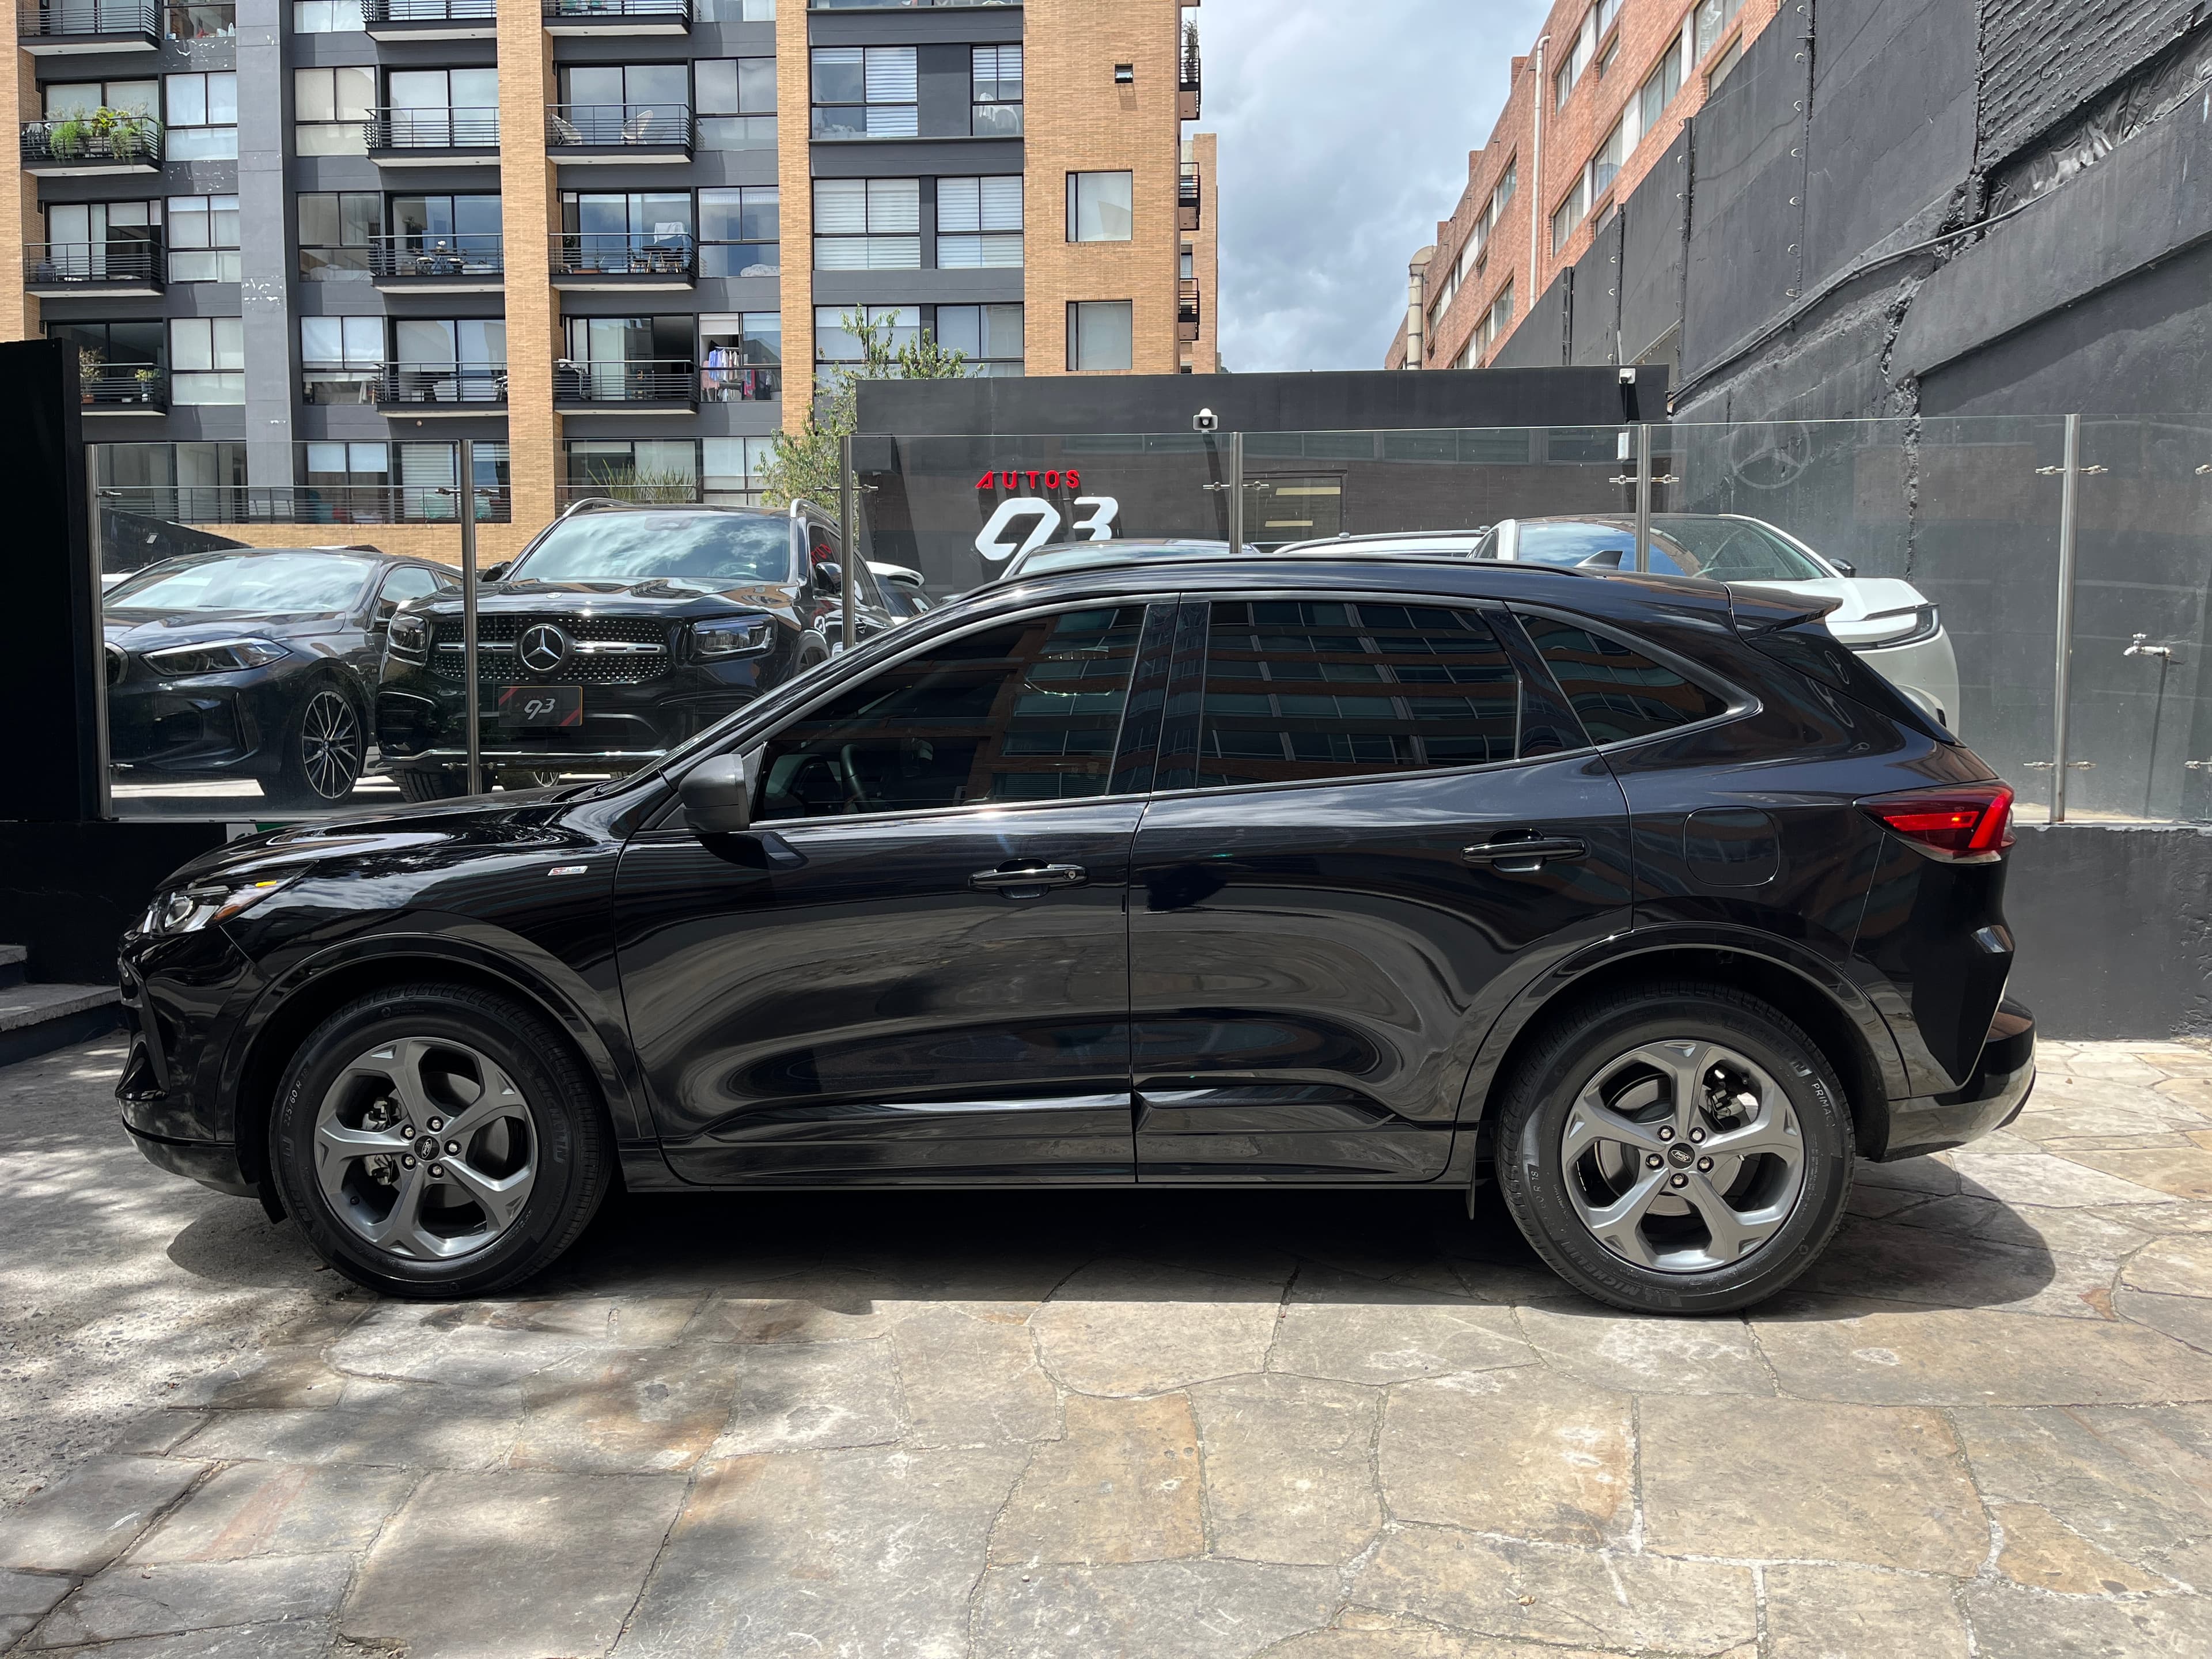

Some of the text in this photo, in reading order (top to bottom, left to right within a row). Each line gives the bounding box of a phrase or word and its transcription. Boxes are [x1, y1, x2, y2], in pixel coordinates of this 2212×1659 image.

[975, 469, 1080, 489] AUTOS
[524, 698, 555, 719] 93
[283, 1067, 309, 1127] 225/60 R 18
[422, 1141, 431, 1156] Ford
[1673, 1151, 1690, 1162] Ford
[1530, 1171, 1539, 1181] 18
